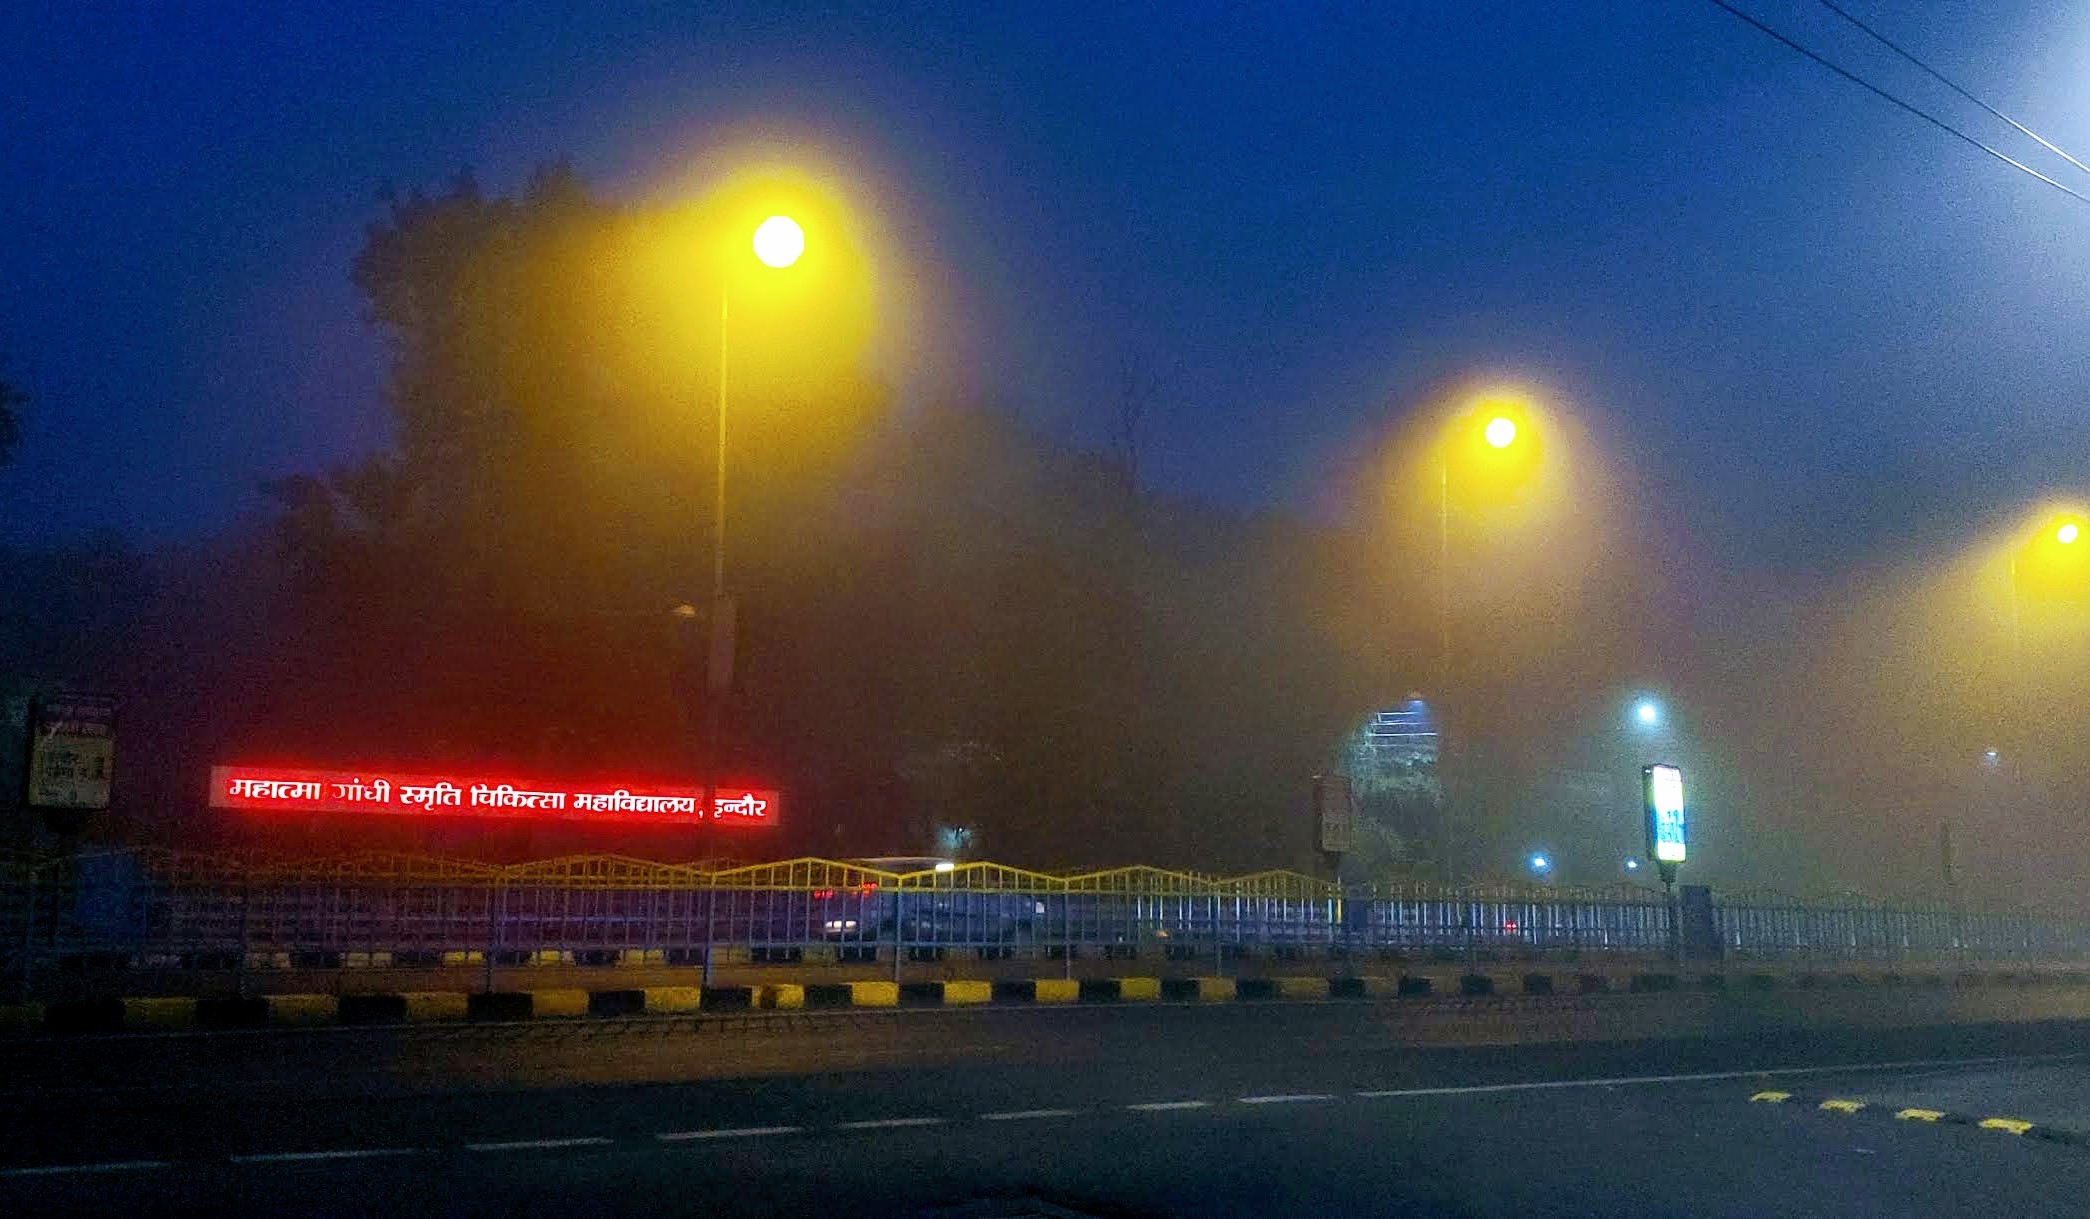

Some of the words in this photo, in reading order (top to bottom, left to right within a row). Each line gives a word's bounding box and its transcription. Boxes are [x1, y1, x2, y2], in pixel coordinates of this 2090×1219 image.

[230, 778, 322, 800] महात्मा
[332, 778, 391, 802] गांधी
[400, 782, 462, 811] स्मृति
[470, 784, 566, 809] चिकित्सा
